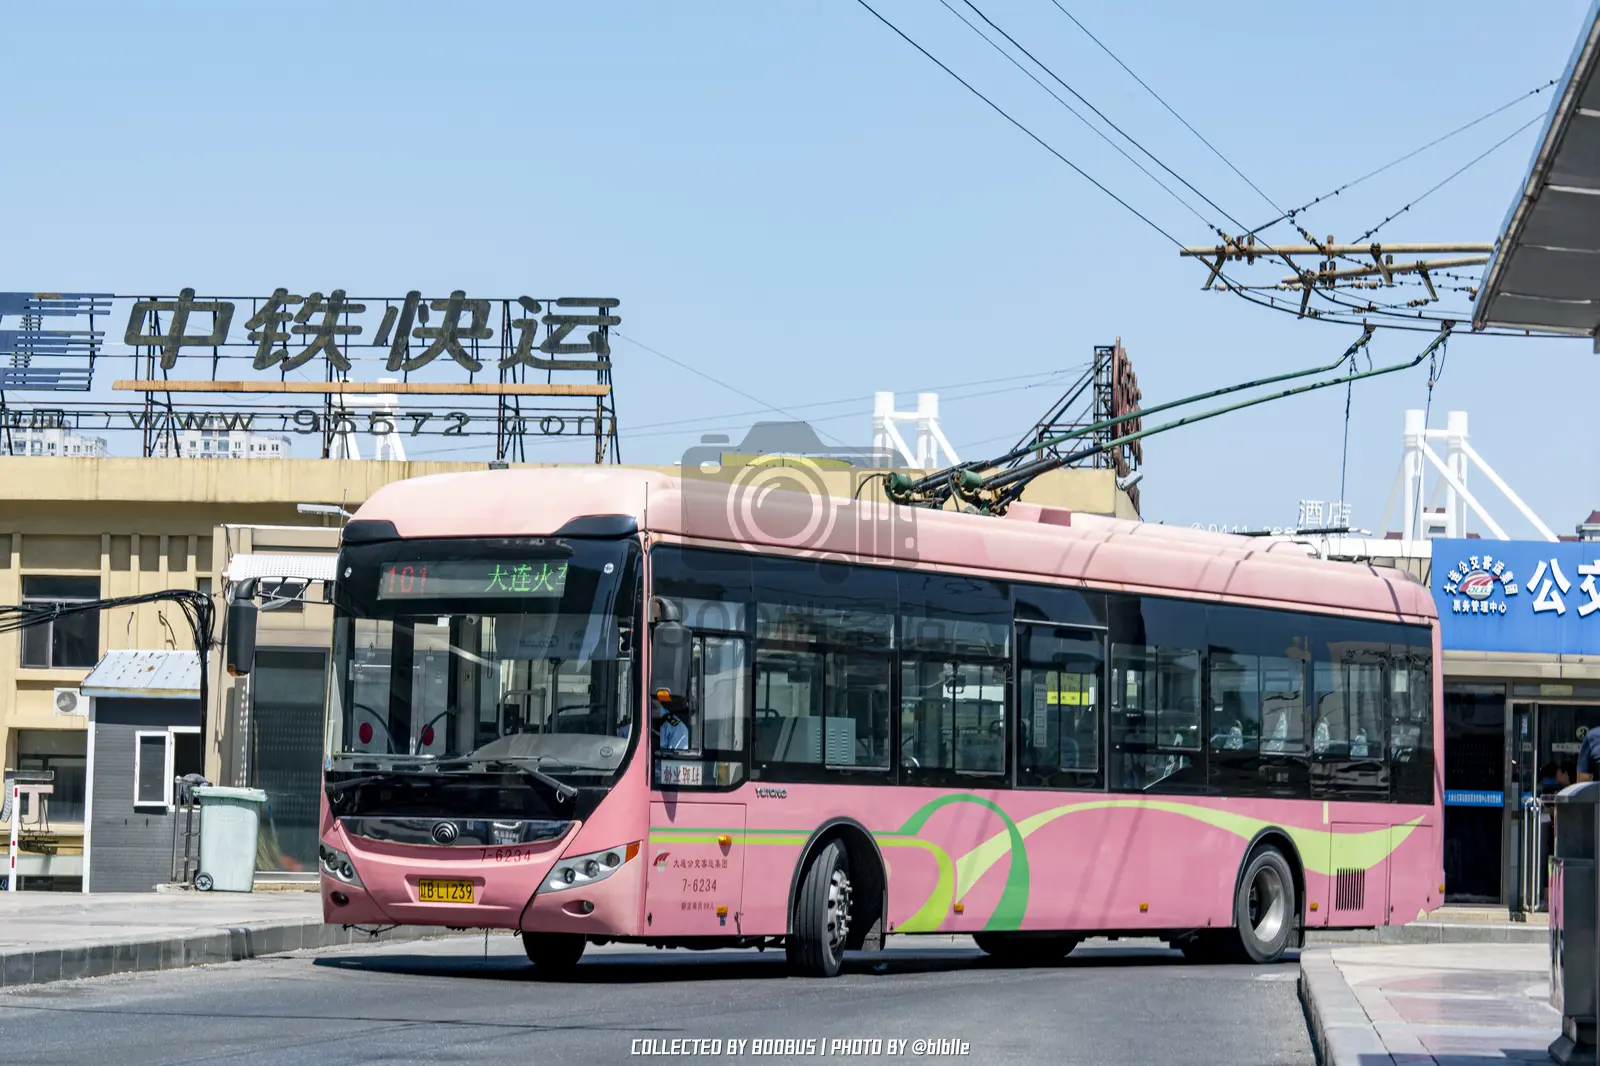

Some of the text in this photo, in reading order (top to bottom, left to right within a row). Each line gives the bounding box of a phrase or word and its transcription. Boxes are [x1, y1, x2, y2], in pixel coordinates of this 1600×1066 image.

[124, 287, 622, 372] 中铁快运
[1299, 499, 1352, 528] 酒店
[388, 564, 428, 596] 101
[1452, 599, 1508, 615] 票务管理中心
[480, 848, 531, 863] 7-6234
[682, 878, 717, 892] 7-6234
